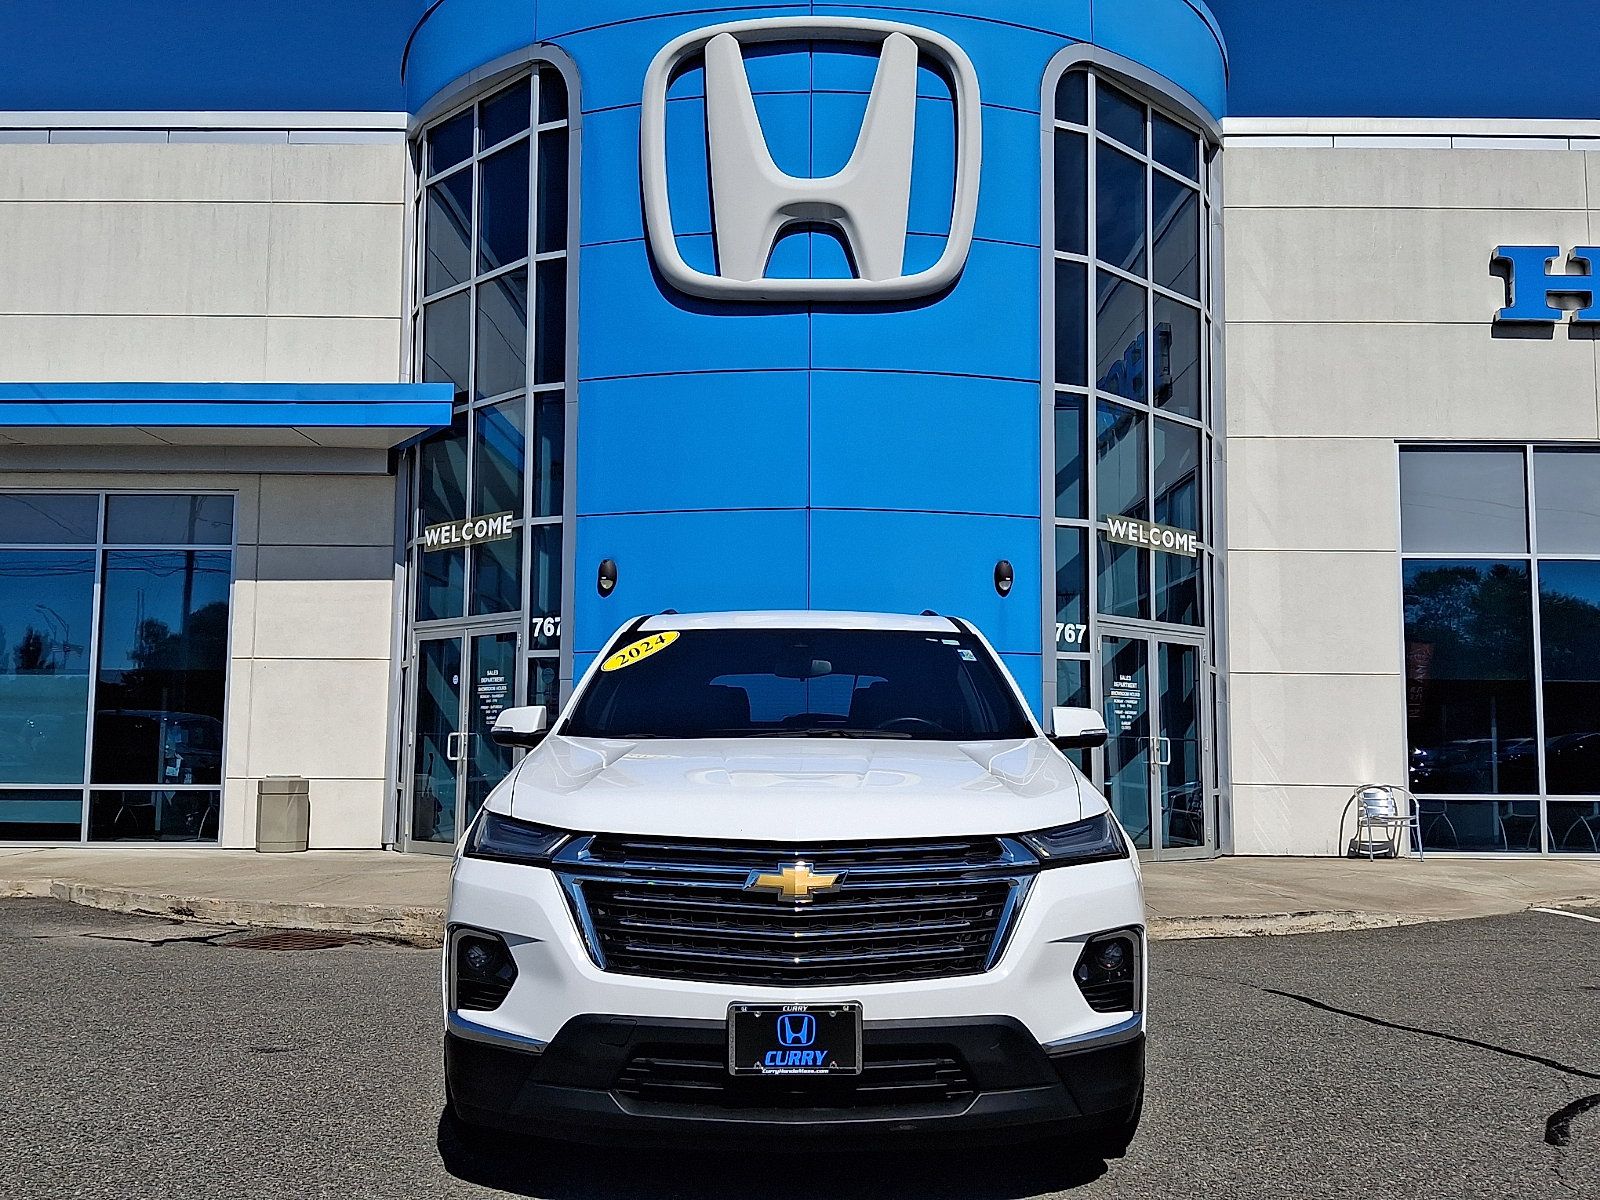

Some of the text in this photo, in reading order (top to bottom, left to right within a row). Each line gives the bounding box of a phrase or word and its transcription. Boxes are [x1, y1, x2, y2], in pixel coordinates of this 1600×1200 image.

[424, 514, 513, 547] WELCOME
[1107, 518, 1197, 554] WELCOME
[532, 616, 561, 637] 767
[1055, 622, 1087, 644] 767
[615, 634, 666, 666] 2024
[764, 1050, 829, 1066] CURRY
